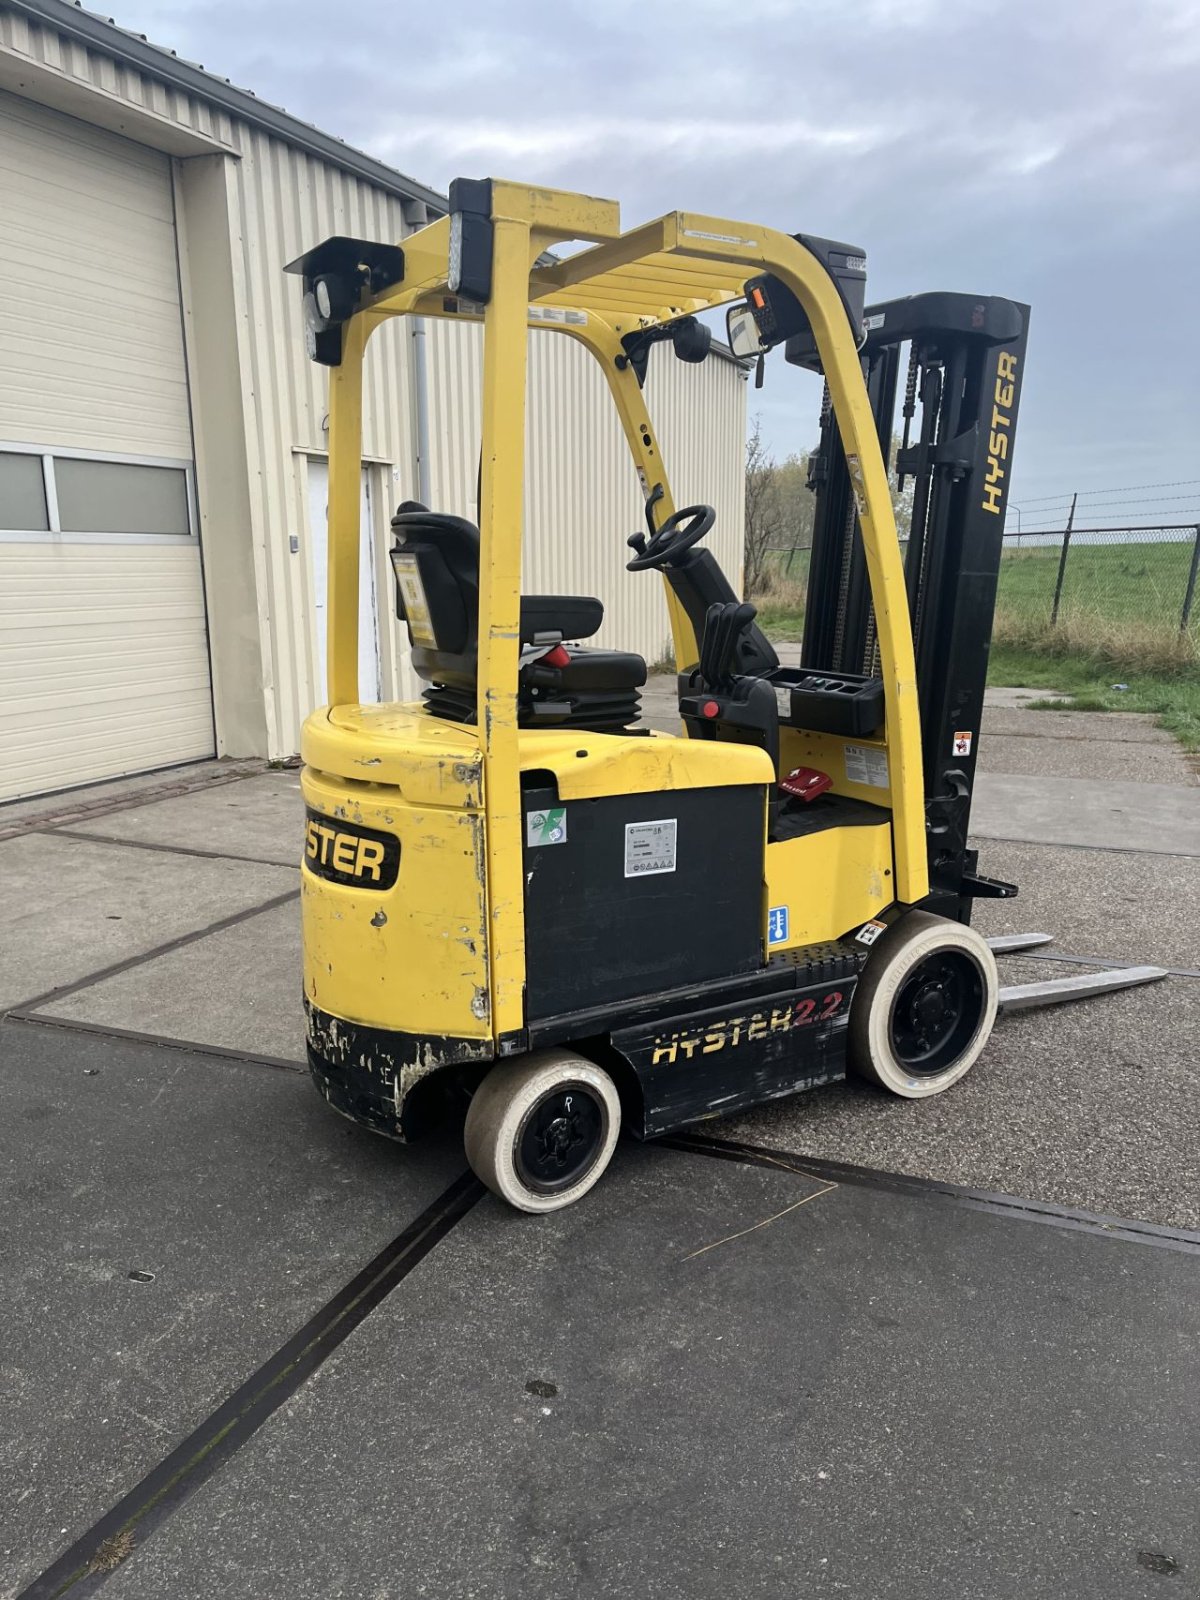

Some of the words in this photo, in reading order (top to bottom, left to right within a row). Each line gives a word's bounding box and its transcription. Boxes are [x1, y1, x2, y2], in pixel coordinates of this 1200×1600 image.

[982, 351, 1018, 515] HYSTER
[305, 818, 385, 881] STER
[795, 991, 843, 1025] 2.2
